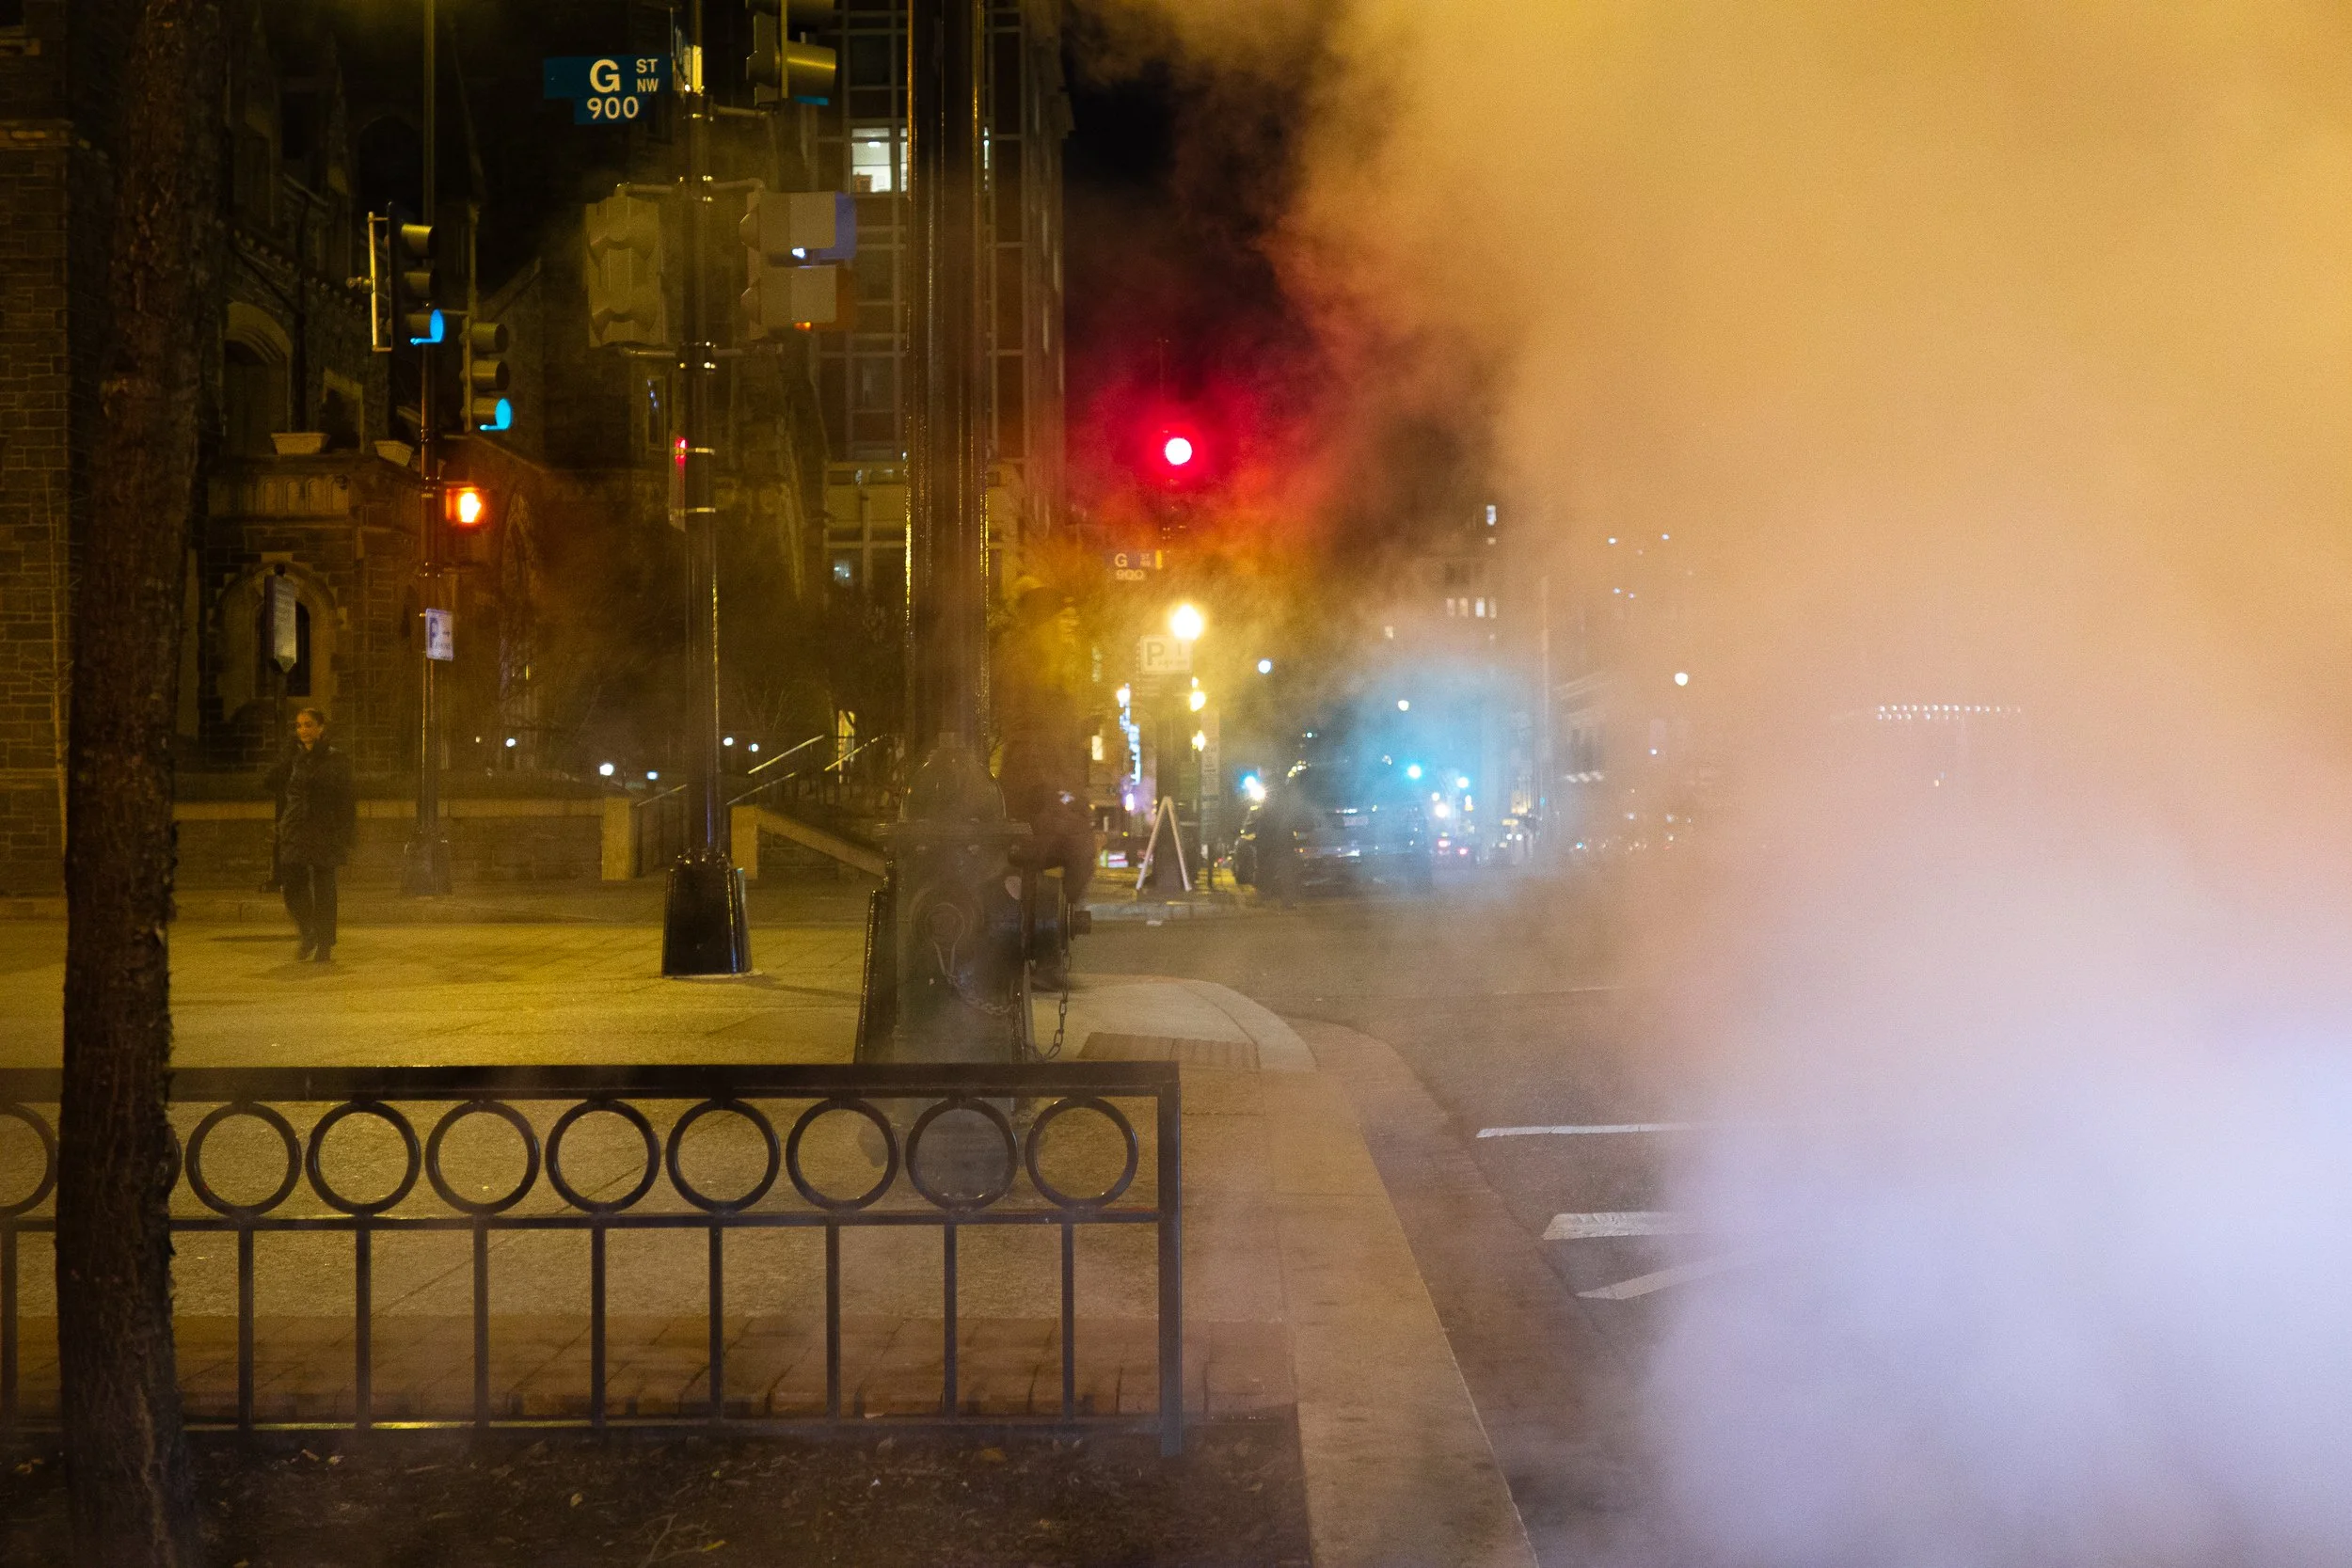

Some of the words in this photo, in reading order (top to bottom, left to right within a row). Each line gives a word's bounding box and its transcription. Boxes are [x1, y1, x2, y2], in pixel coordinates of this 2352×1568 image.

[590, 59, 621, 93] G
[636, 58, 658, 73] ST
[636, 78, 659, 92] NW
[587, 96, 640, 119] 900
[1114, 553, 1128, 567] G
